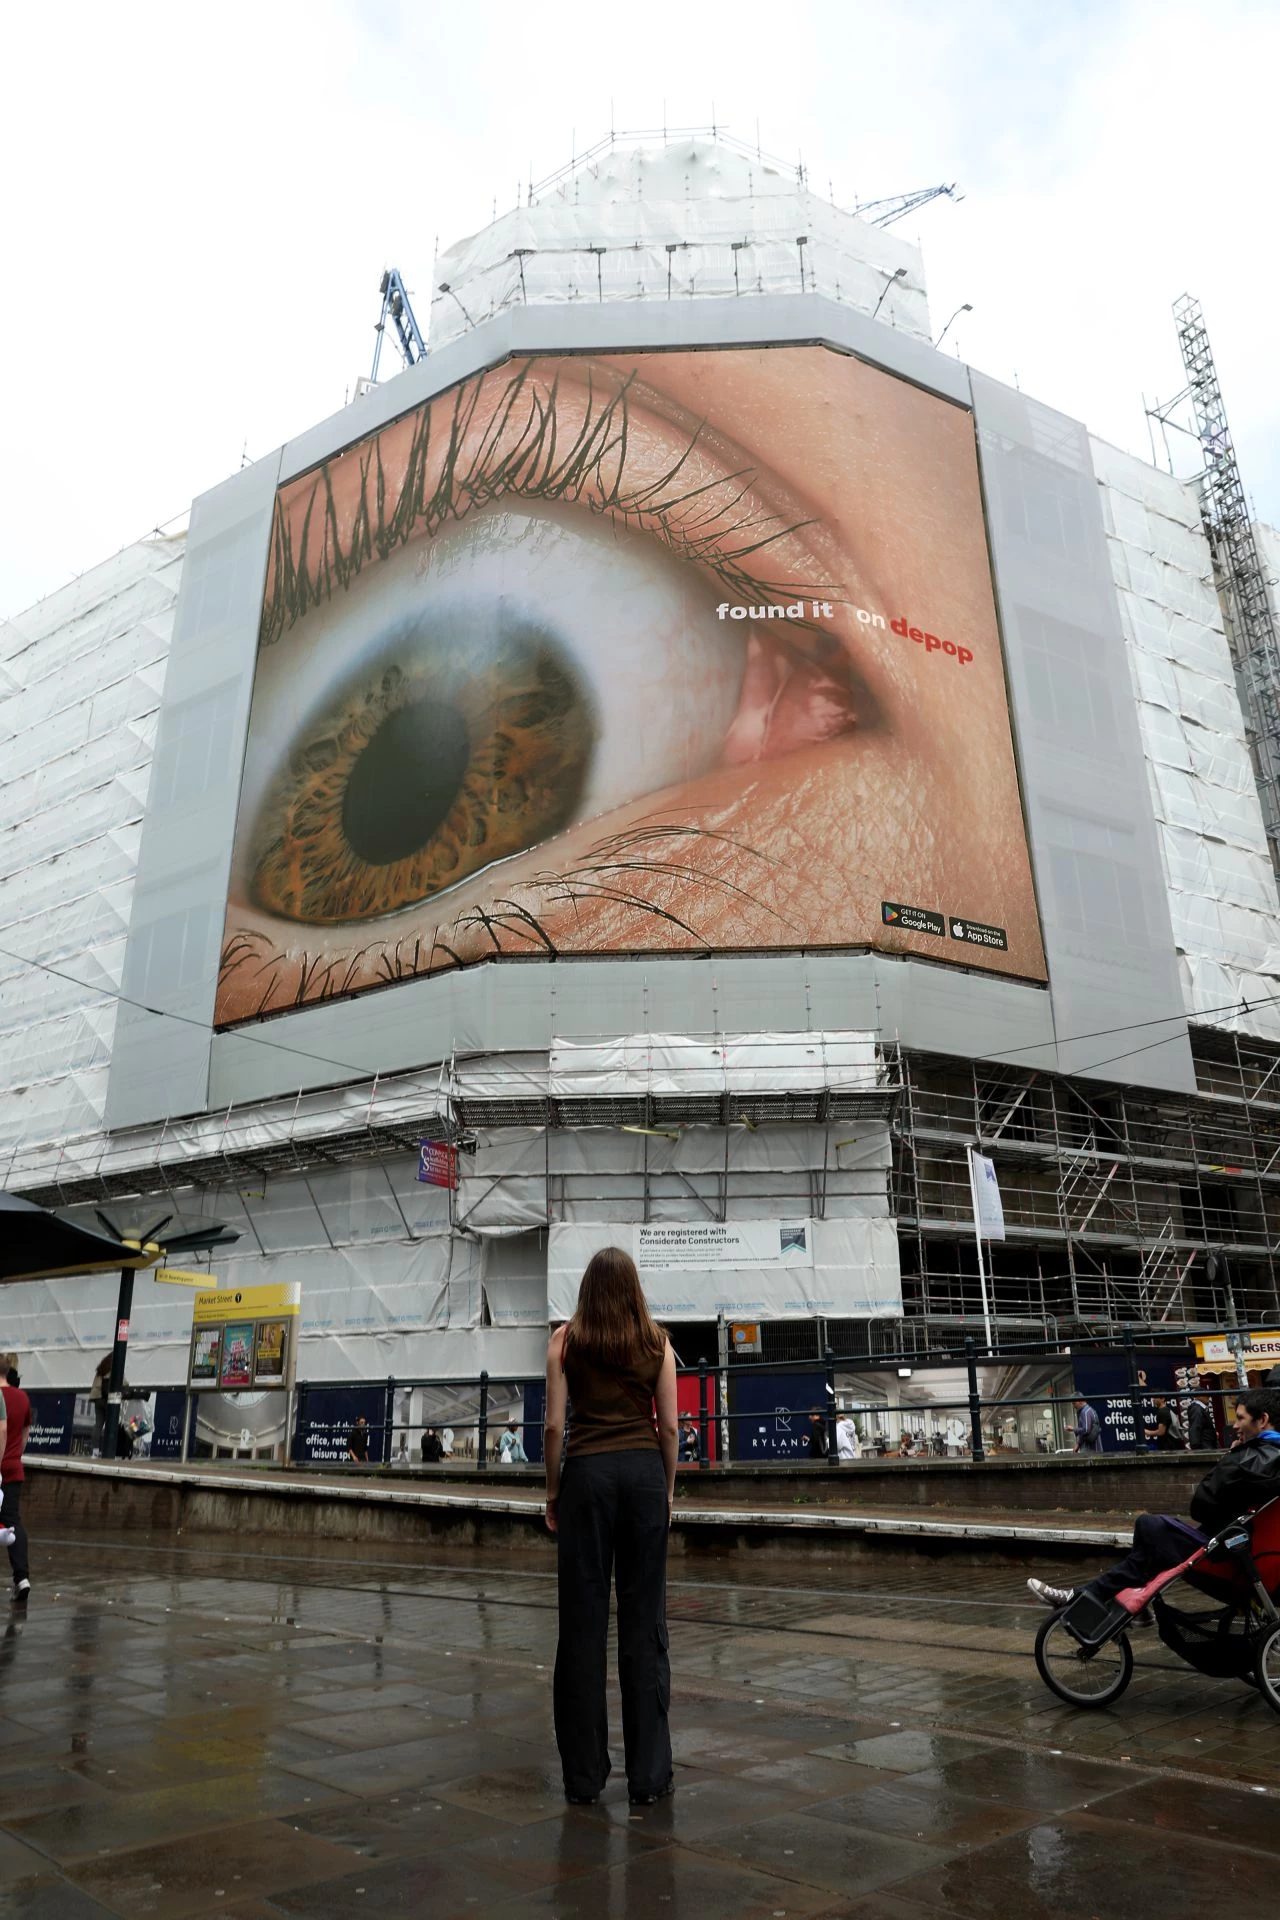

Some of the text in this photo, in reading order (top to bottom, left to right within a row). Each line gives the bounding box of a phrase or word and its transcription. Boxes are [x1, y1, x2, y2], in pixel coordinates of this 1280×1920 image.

[716, 601, 973, 665] found it on depop
[900, 908, 912, 916] GET
[917, 911, 926, 919] ON
[901, 916, 941, 934] Google Play
[967, 931, 1004, 946] App Store
[667, 1228, 708, 1237] registered
[709, 1227, 727, 1235] with
[639, 1236, 740, 1245] Considerate Constructors
[198, 1295, 233, 1305] Market Street
[1229, 1342, 1280, 1355] RGERS
[1104, 1412, 1134, 1424] office
[1115, 1428, 1136, 1440] leis
[32, 1435, 50, 1445] elegant
[49, 1436, 61, 1446] past
[156, 1438, 184, 1447] RYLAN
[306, 1434, 330, 1447] office,
[311, 1448, 338, 1459] leisure
